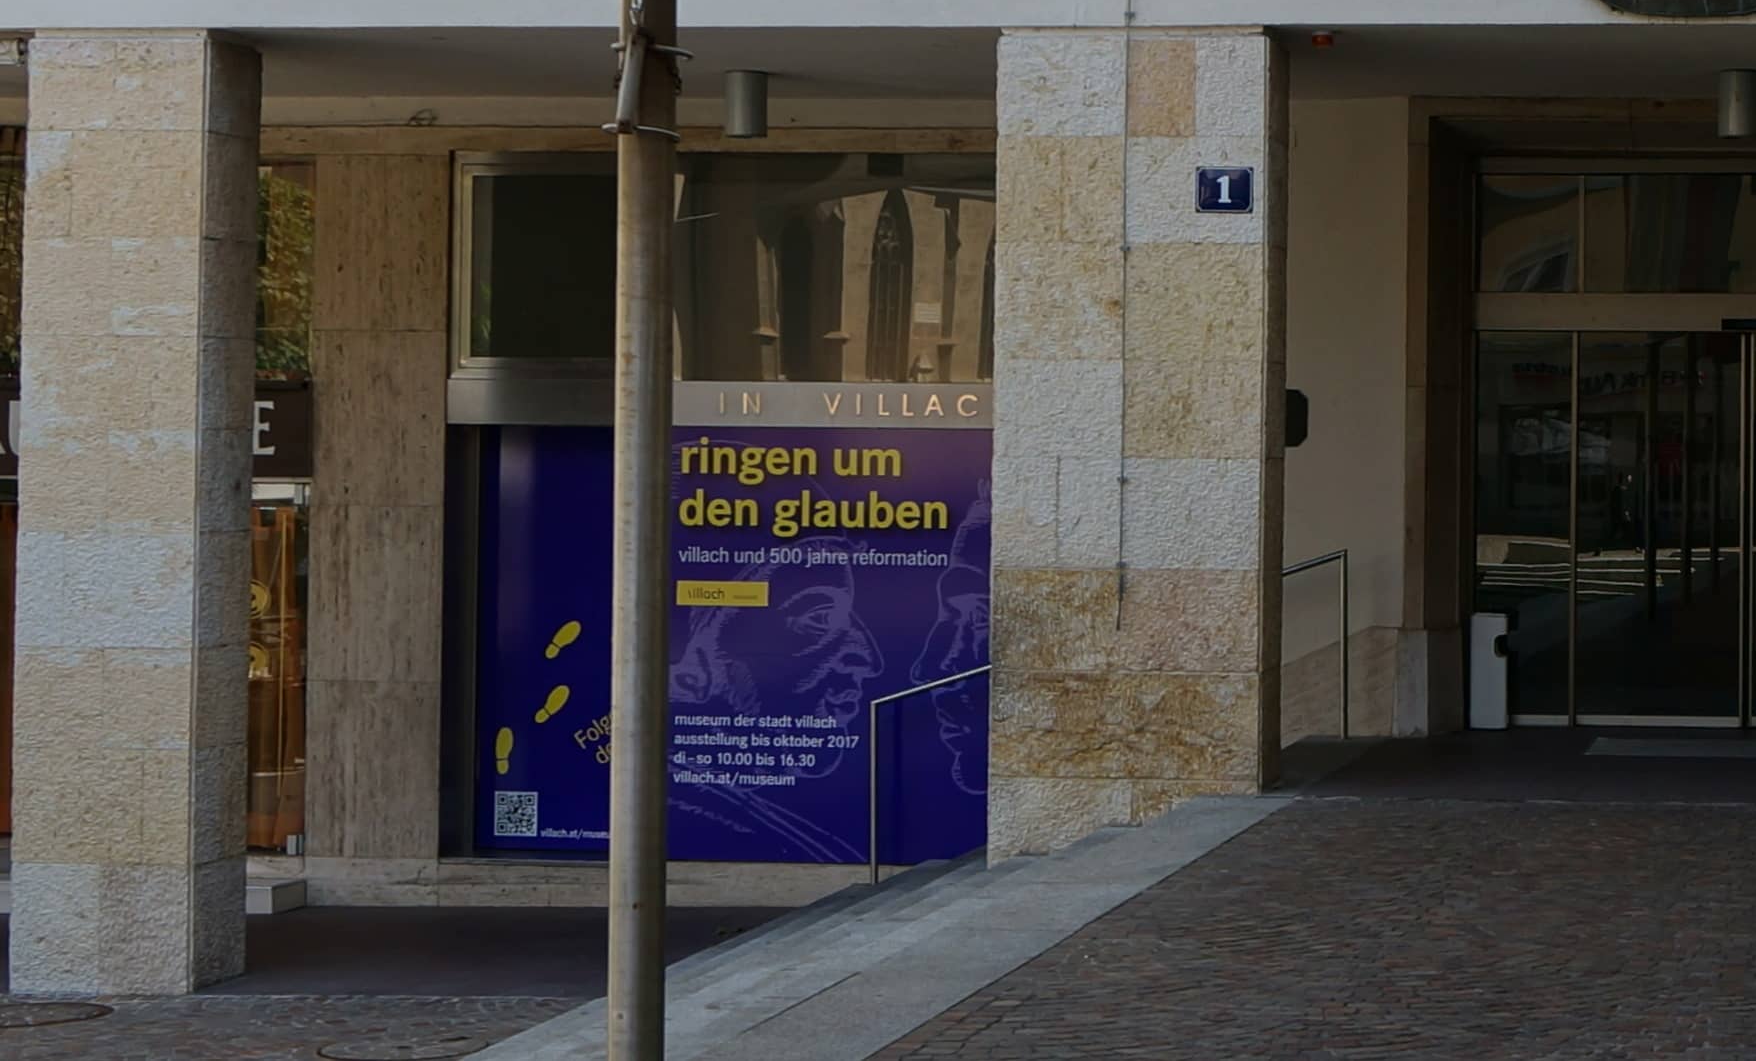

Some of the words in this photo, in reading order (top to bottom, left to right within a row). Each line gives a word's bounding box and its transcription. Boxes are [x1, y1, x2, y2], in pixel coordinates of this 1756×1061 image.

[1216, 175, 1232, 203] 1
[718, 391, 761, 416] IN
[823, 392, 980, 417] VILLAC
[680, 437, 818, 486] ringen
[833, 447, 902, 477] um
[678, 489, 759, 527] den
[772, 489, 949, 538] glauben
[678, 546, 729, 564] villach
[734, 547, 765, 564] und
[770, 548, 802, 565] 500
[806, 548, 849, 568] jahre
[852, 548, 948, 566] reformation
[573, 714, 610, 750] Folg
[674, 715, 731, 727] museum
[733, 714, 756, 728] der
[758, 715, 792, 729] stadt
[795, 716, 837, 729] villach
[674, 732, 748, 750] ausstellung
[751, 733, 771, 747] bis
[773, 734, 825, 748] oktober
[827, 735, 860, 749] 2017
[717, 752, 753, 766] 10.00
[755, 752, 775, 767] bis
[780, 753, 816, 768] 16.30
[673, 770, 795, 788] villach.at/museum
